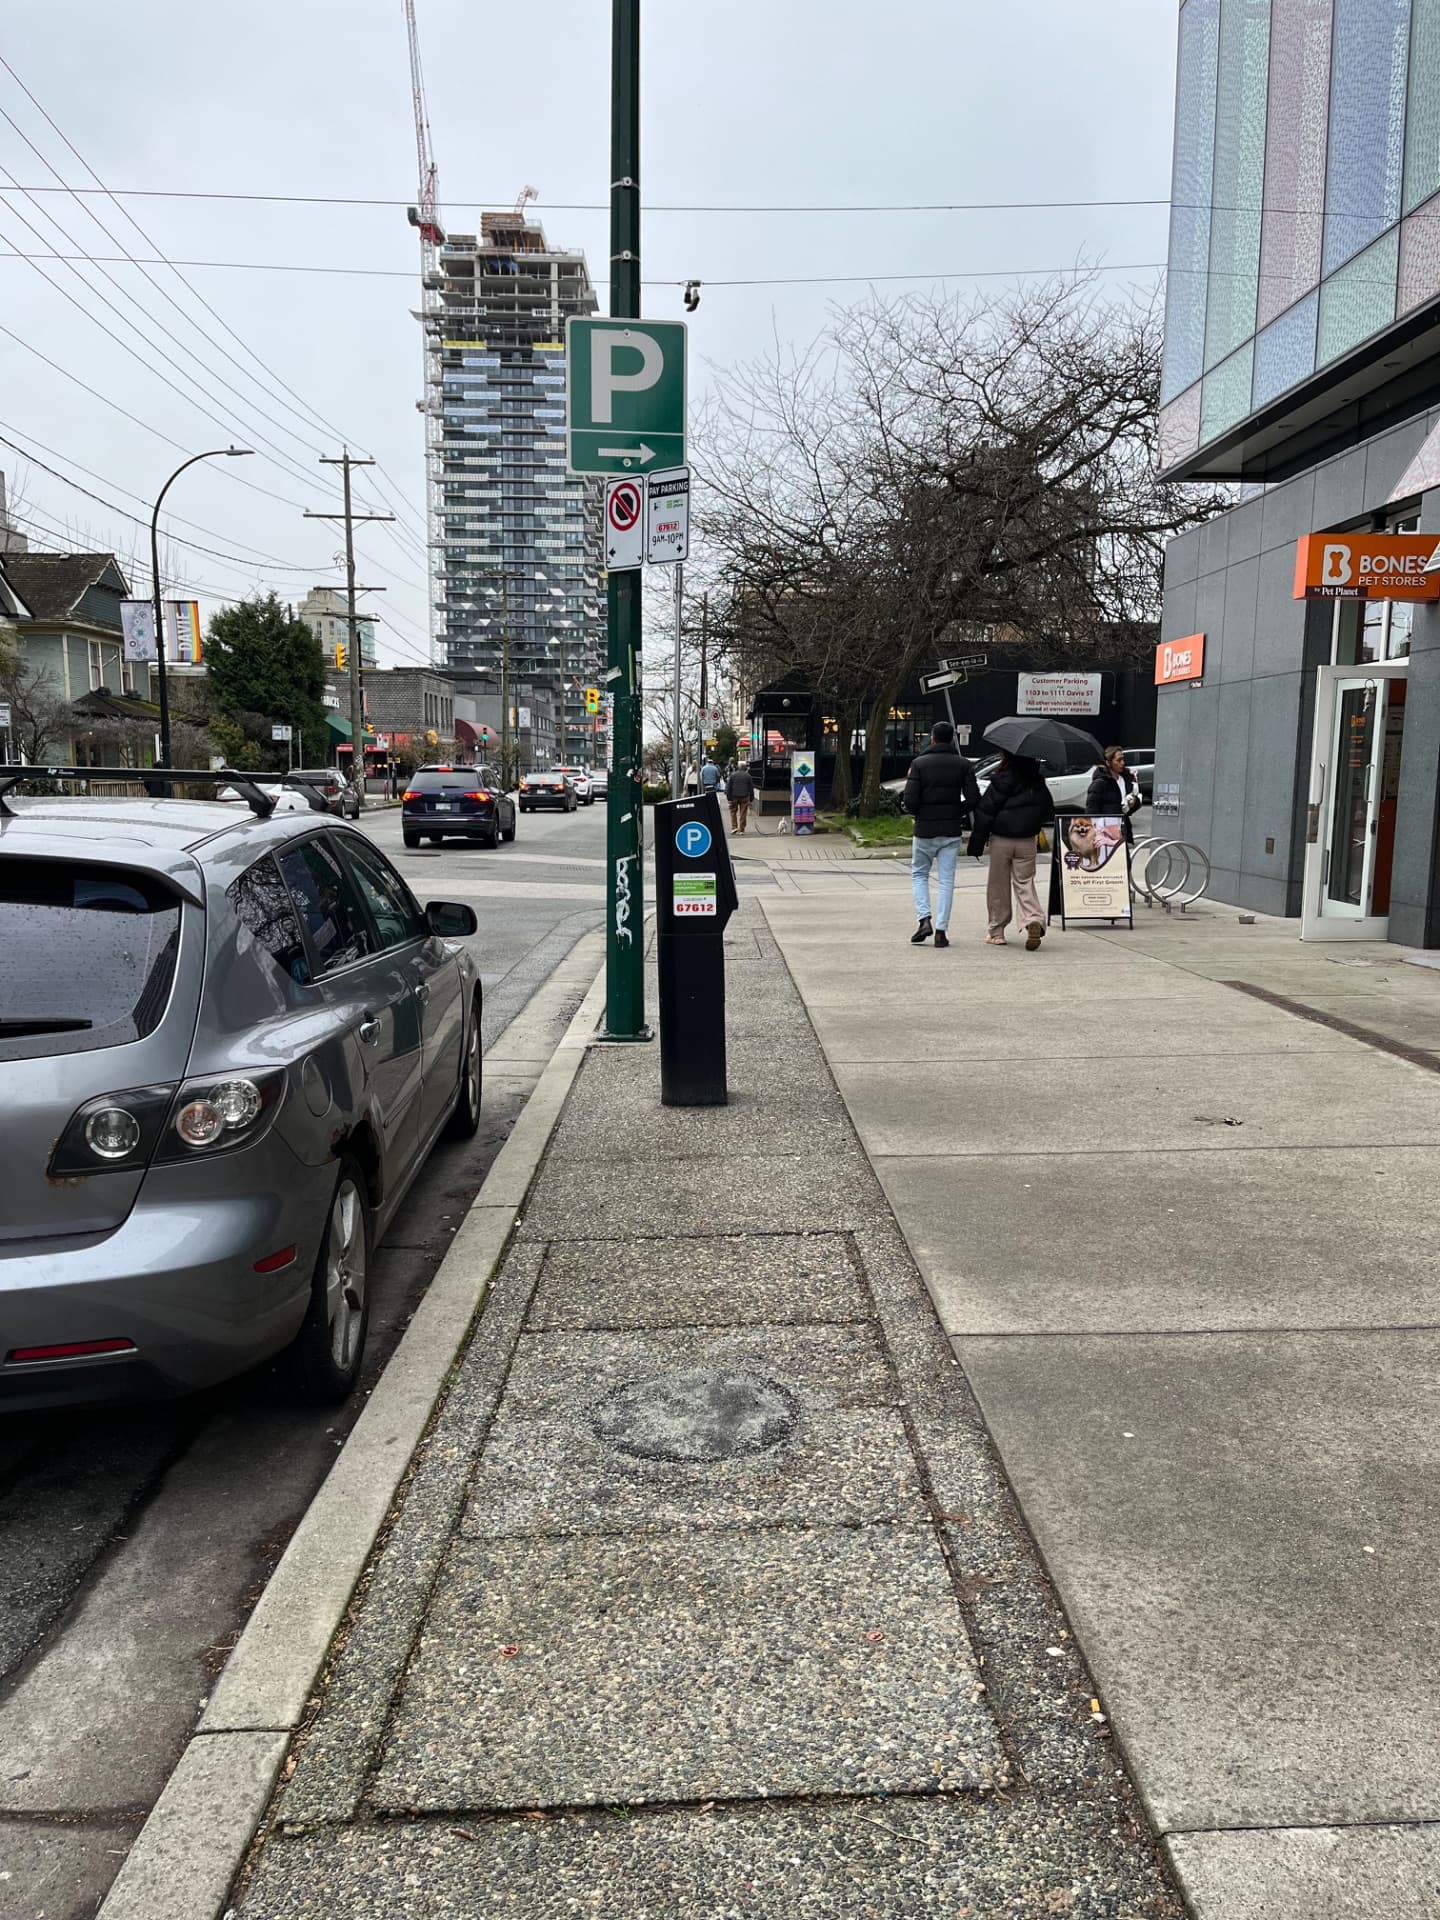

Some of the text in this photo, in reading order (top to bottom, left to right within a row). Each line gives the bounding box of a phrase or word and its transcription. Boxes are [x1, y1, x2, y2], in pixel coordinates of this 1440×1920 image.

[591, 329, 664, 423] P
[650, 481, 689, 496] PAY PARKING
[1359, 555, 1427, 574] BONES
[1359, 576, 1427, 586] PET STORES
[1321, 587, 1334, 596] Pet
[1335, 586, 1358, 596] Planet
[176, 612, 192, 651] DAVIE
[687, 829, 702, 851] P
[676, 903, 714, 912] 67612
